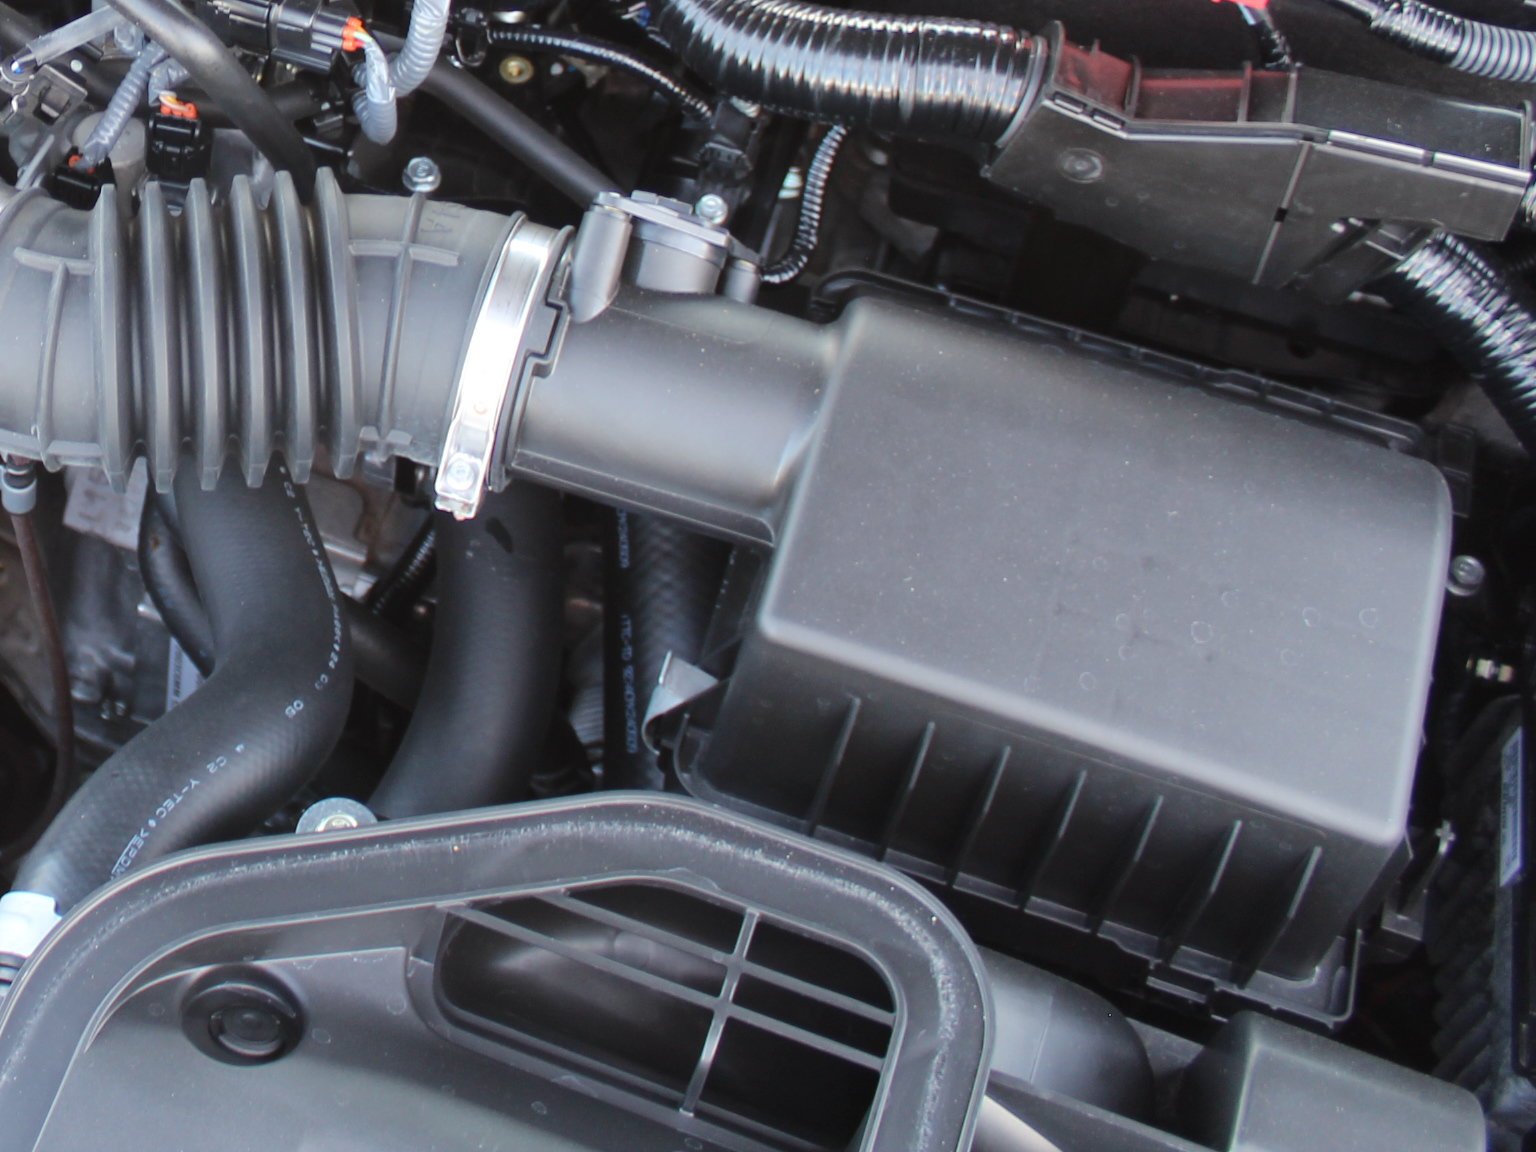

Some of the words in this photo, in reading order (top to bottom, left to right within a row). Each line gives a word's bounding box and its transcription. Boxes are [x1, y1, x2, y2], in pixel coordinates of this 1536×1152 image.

[206, 755, 228, 774] C2
[155, 778, 201, 819] Y-TEC
[110, 827, 151, 881] >EPDM
